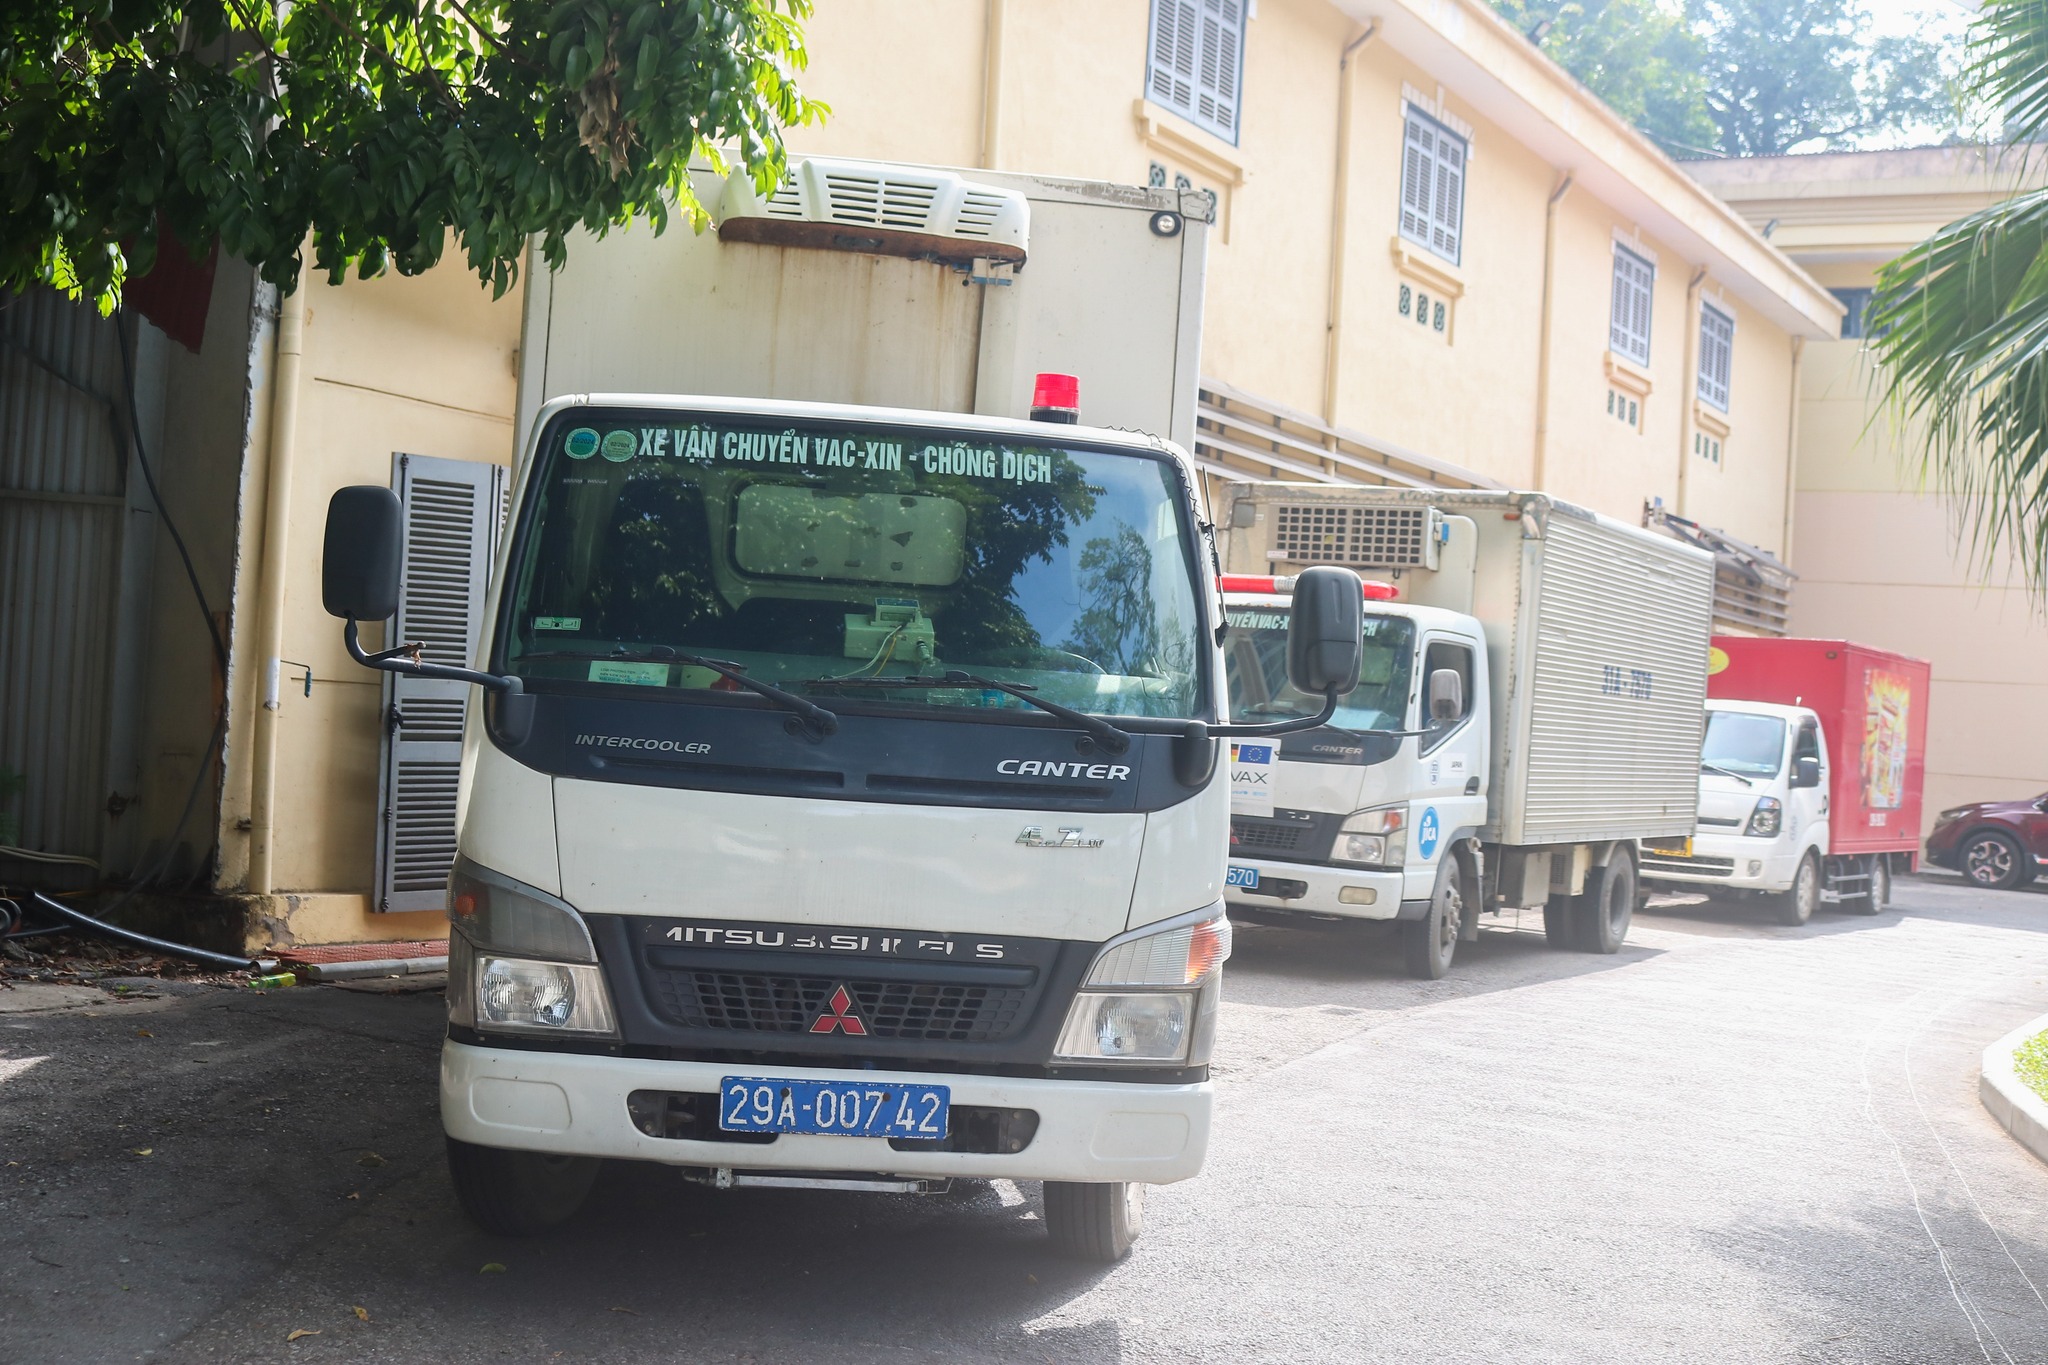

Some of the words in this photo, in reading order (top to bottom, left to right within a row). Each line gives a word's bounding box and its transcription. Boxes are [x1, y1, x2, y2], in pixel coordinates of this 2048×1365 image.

[639, 428, 665, 457] XE
[674, 425, 717, 463] VẬN
[723, 428, 807, 464] CHUYỂN
[814, 437, 902, 471] VAC-XIN
[1002, 452, 1051, 486] DỊCH
[574, 734, 712, 755] INTERCOOLER
[1311, 744, 1363, 754] CANTER
[996, 759, 1131, 781] CANTER
[1230, 770, 1269, 785] VAX
[1227, 867, 1254, 886] 570
